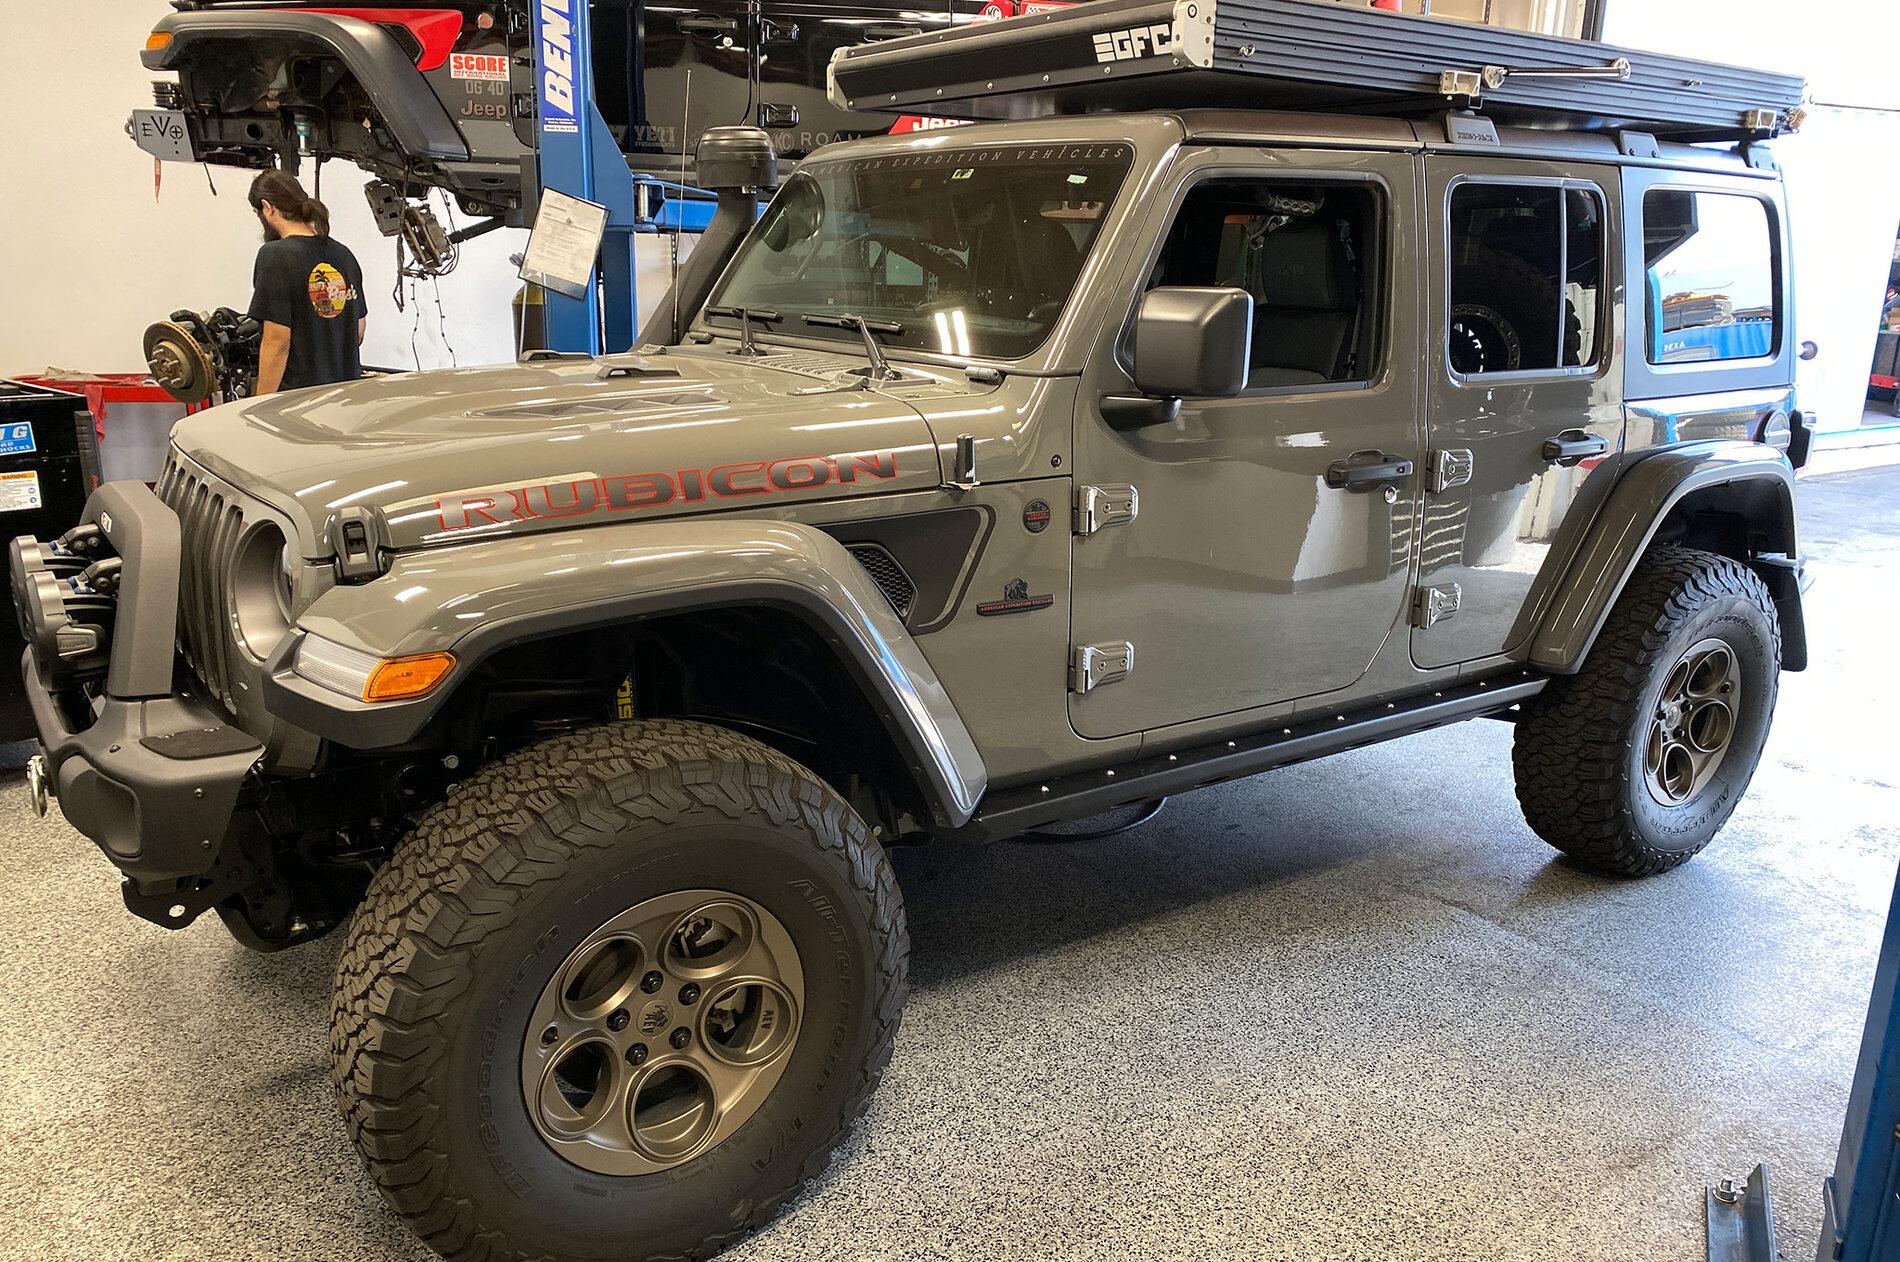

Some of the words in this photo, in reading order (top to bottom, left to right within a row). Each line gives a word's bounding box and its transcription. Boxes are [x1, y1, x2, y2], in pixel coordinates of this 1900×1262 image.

[453, 55, 507, 72] SCORE
[488, 82, 504, 95] 40
[460, 100, 507, 120] Jeep
[892, 152, 1002, 168] EXPEDITION
[1016, 146, 1124, 161] VEHICLES
[438, 451, 897, 532] RUBICON
